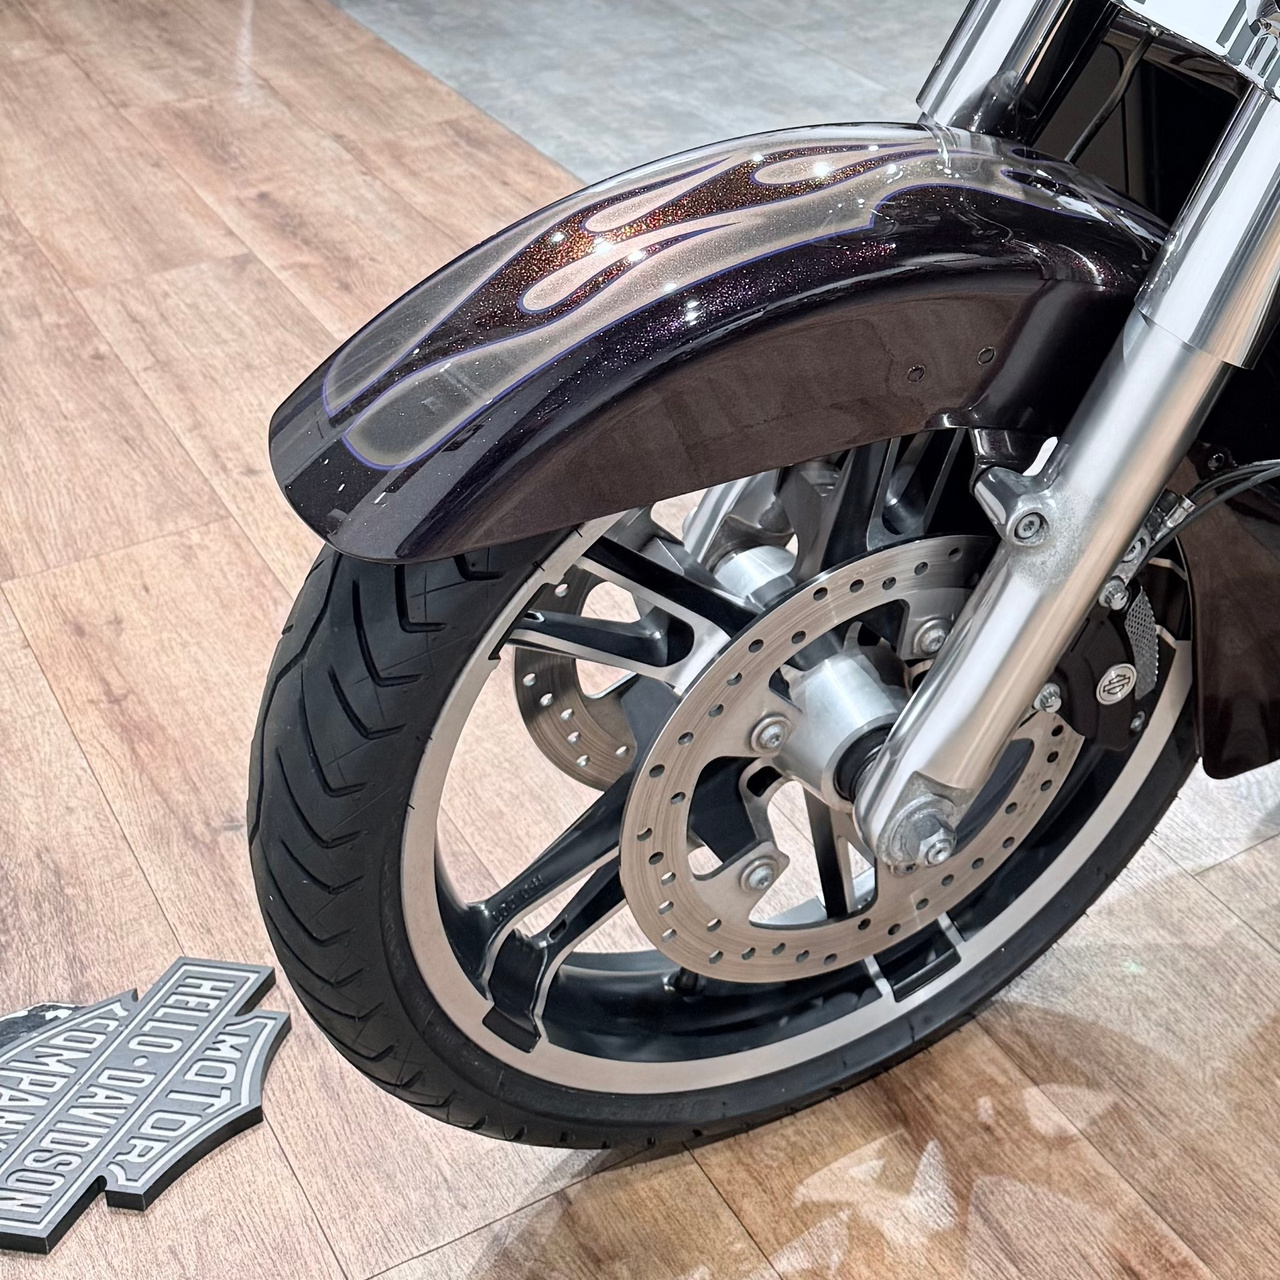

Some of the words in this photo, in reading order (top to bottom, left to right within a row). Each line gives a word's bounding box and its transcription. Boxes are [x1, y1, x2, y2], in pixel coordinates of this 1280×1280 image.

[128, 975, 237, 1054] HELLO
[0, 1017, 120, 1153] COMPAN
[0, 1066, 157, 1214] DAVIDSON
[113, 1033, 251, 1164] MOTOR
